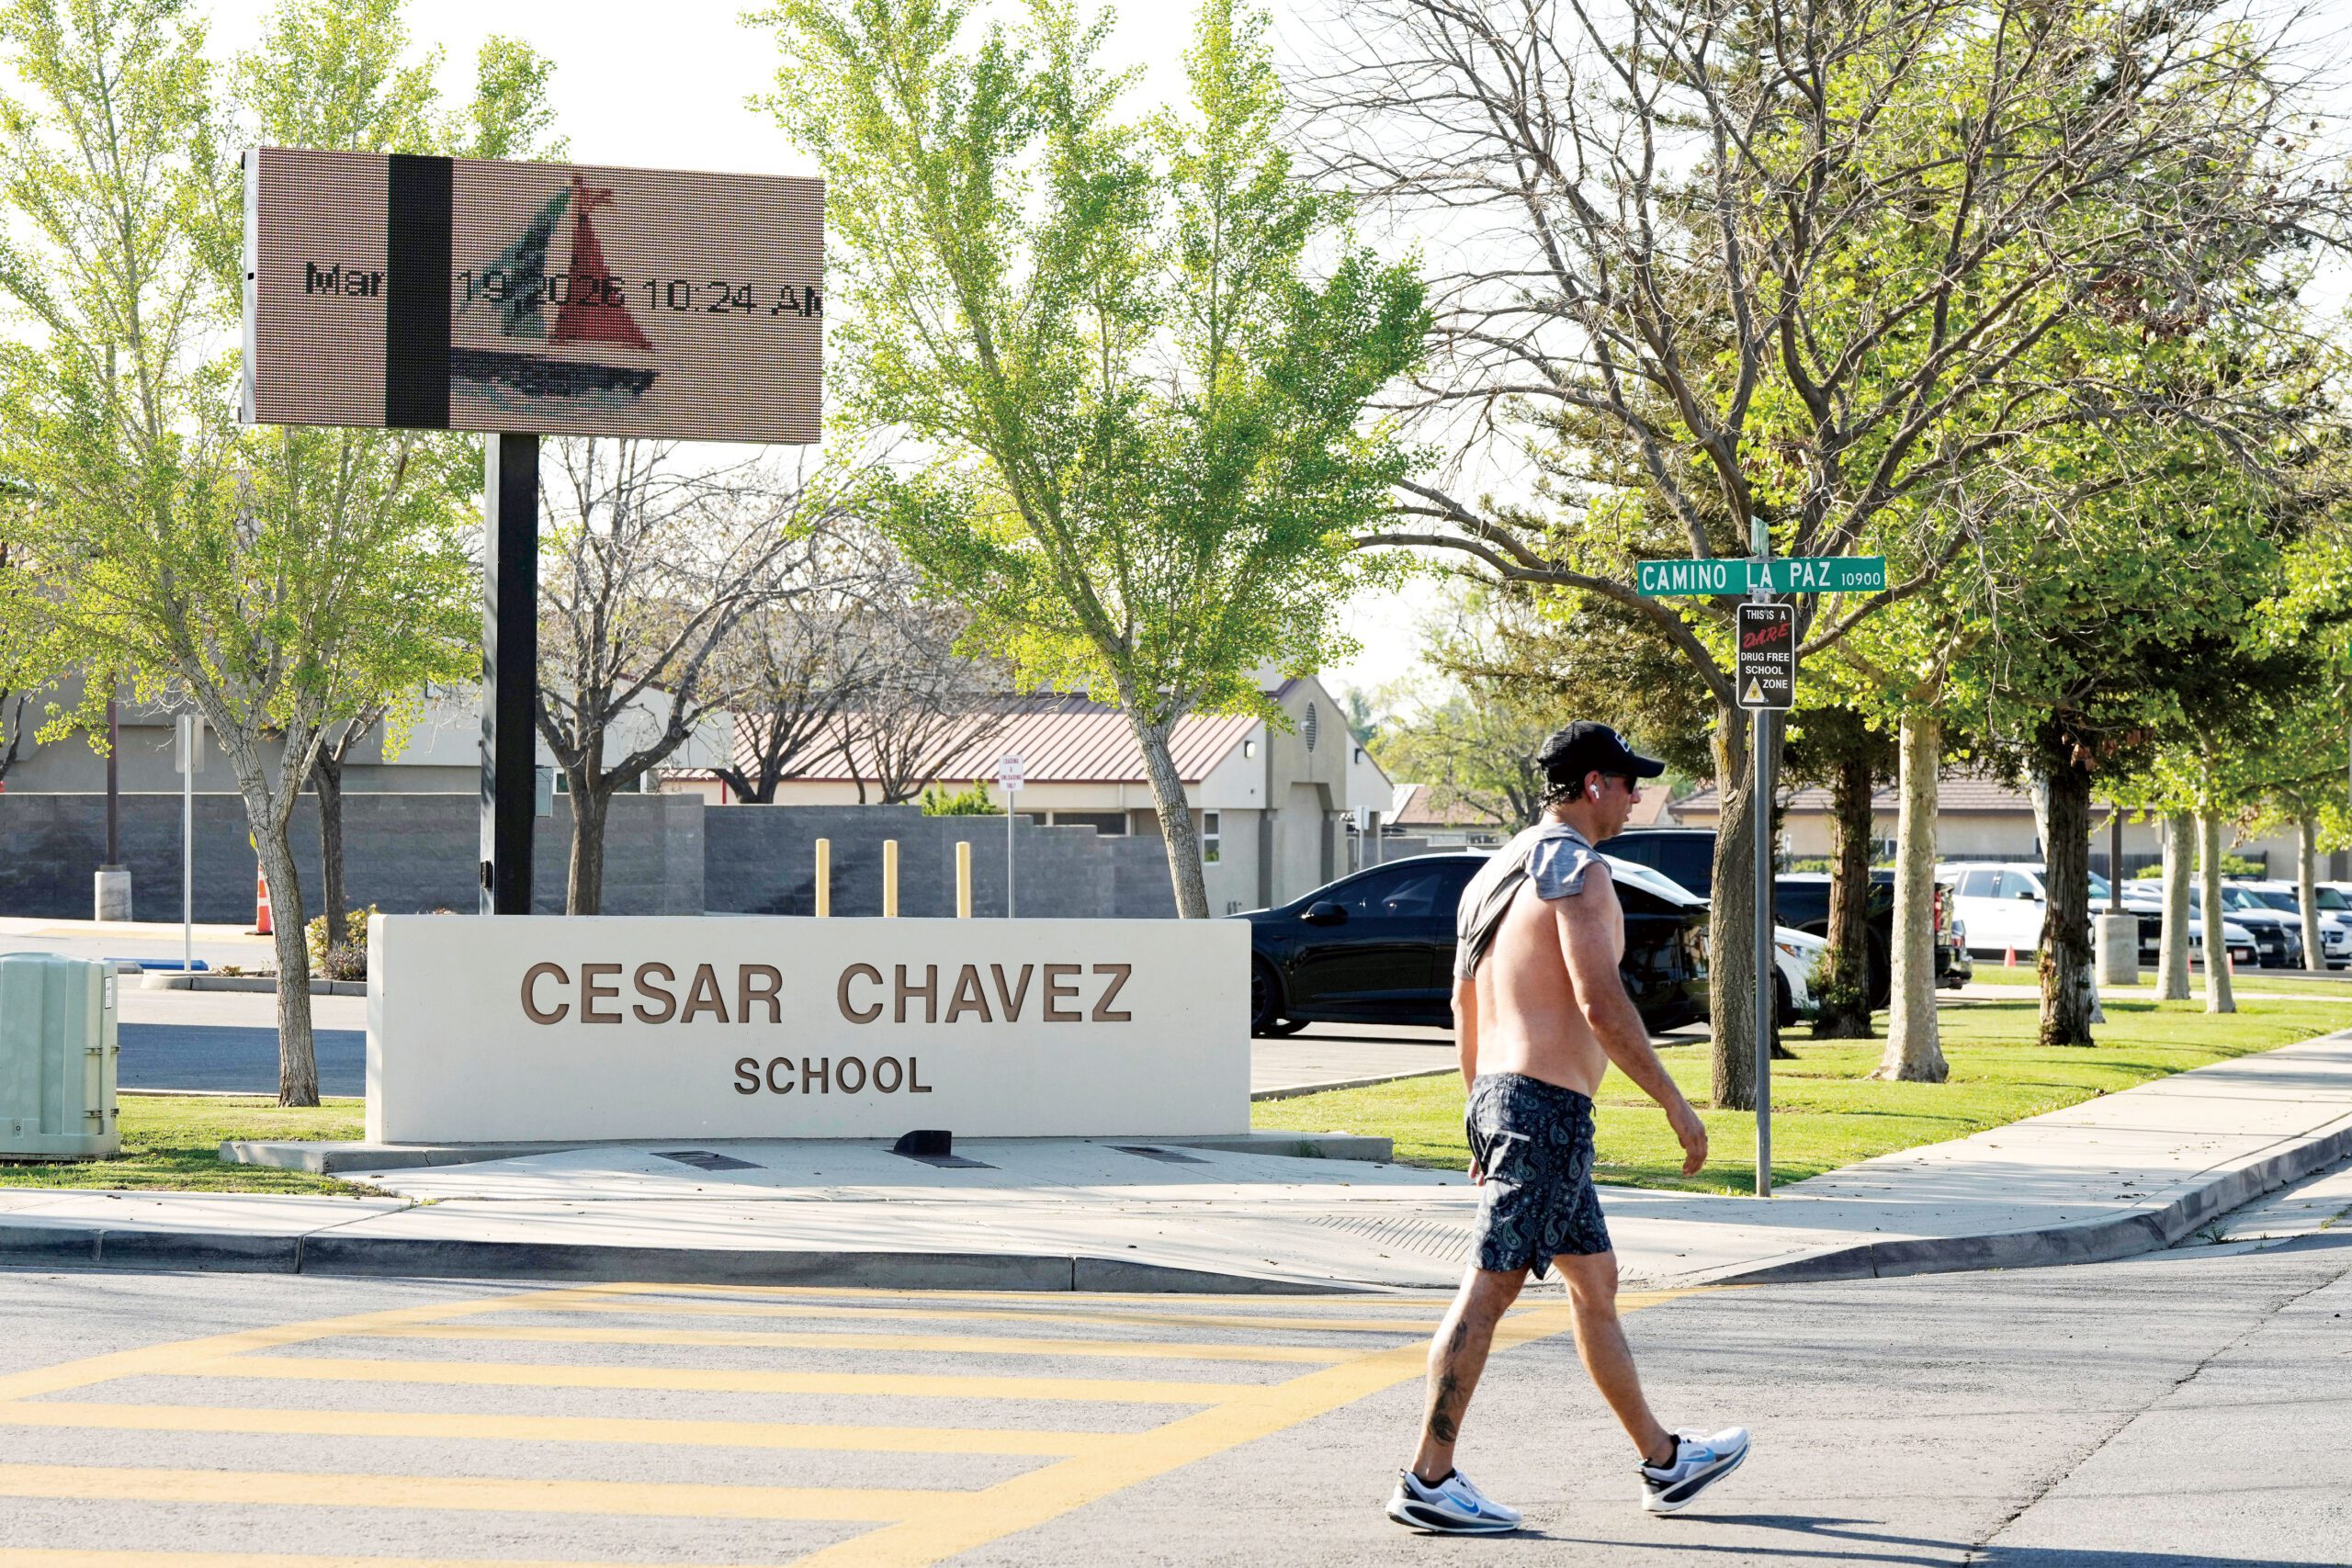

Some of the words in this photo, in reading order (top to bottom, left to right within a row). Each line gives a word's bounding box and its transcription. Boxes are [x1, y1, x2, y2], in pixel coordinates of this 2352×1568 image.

[459, 269, 505, 303] 19
[644, 278, 757, 314] 10:24
[1642, 564, 1726, 591] CAMINO
[1747, 562, 1773, 589] LA
[1789, 561, 1831, 587] PAZ
[1840, 572, 1882, 587] 10900
[1746, 609, 1765, 620] THIS
[1766, 610, 1775, 620] IS
[1780, 610, 1786, 620] A
[1740, 652, 1765, 661] DRUG
[1766, 652, 1791, 662] FREE
[1745, 665, 1784, 675] SCHOOL
[1762, 679, 1789, 689] ZONE
[521, 962, 784, 1025] CESAR
[836, 962, 1133, 1024] CHAVEZ
[734, 1055, 933, 1095] SCHOOL
